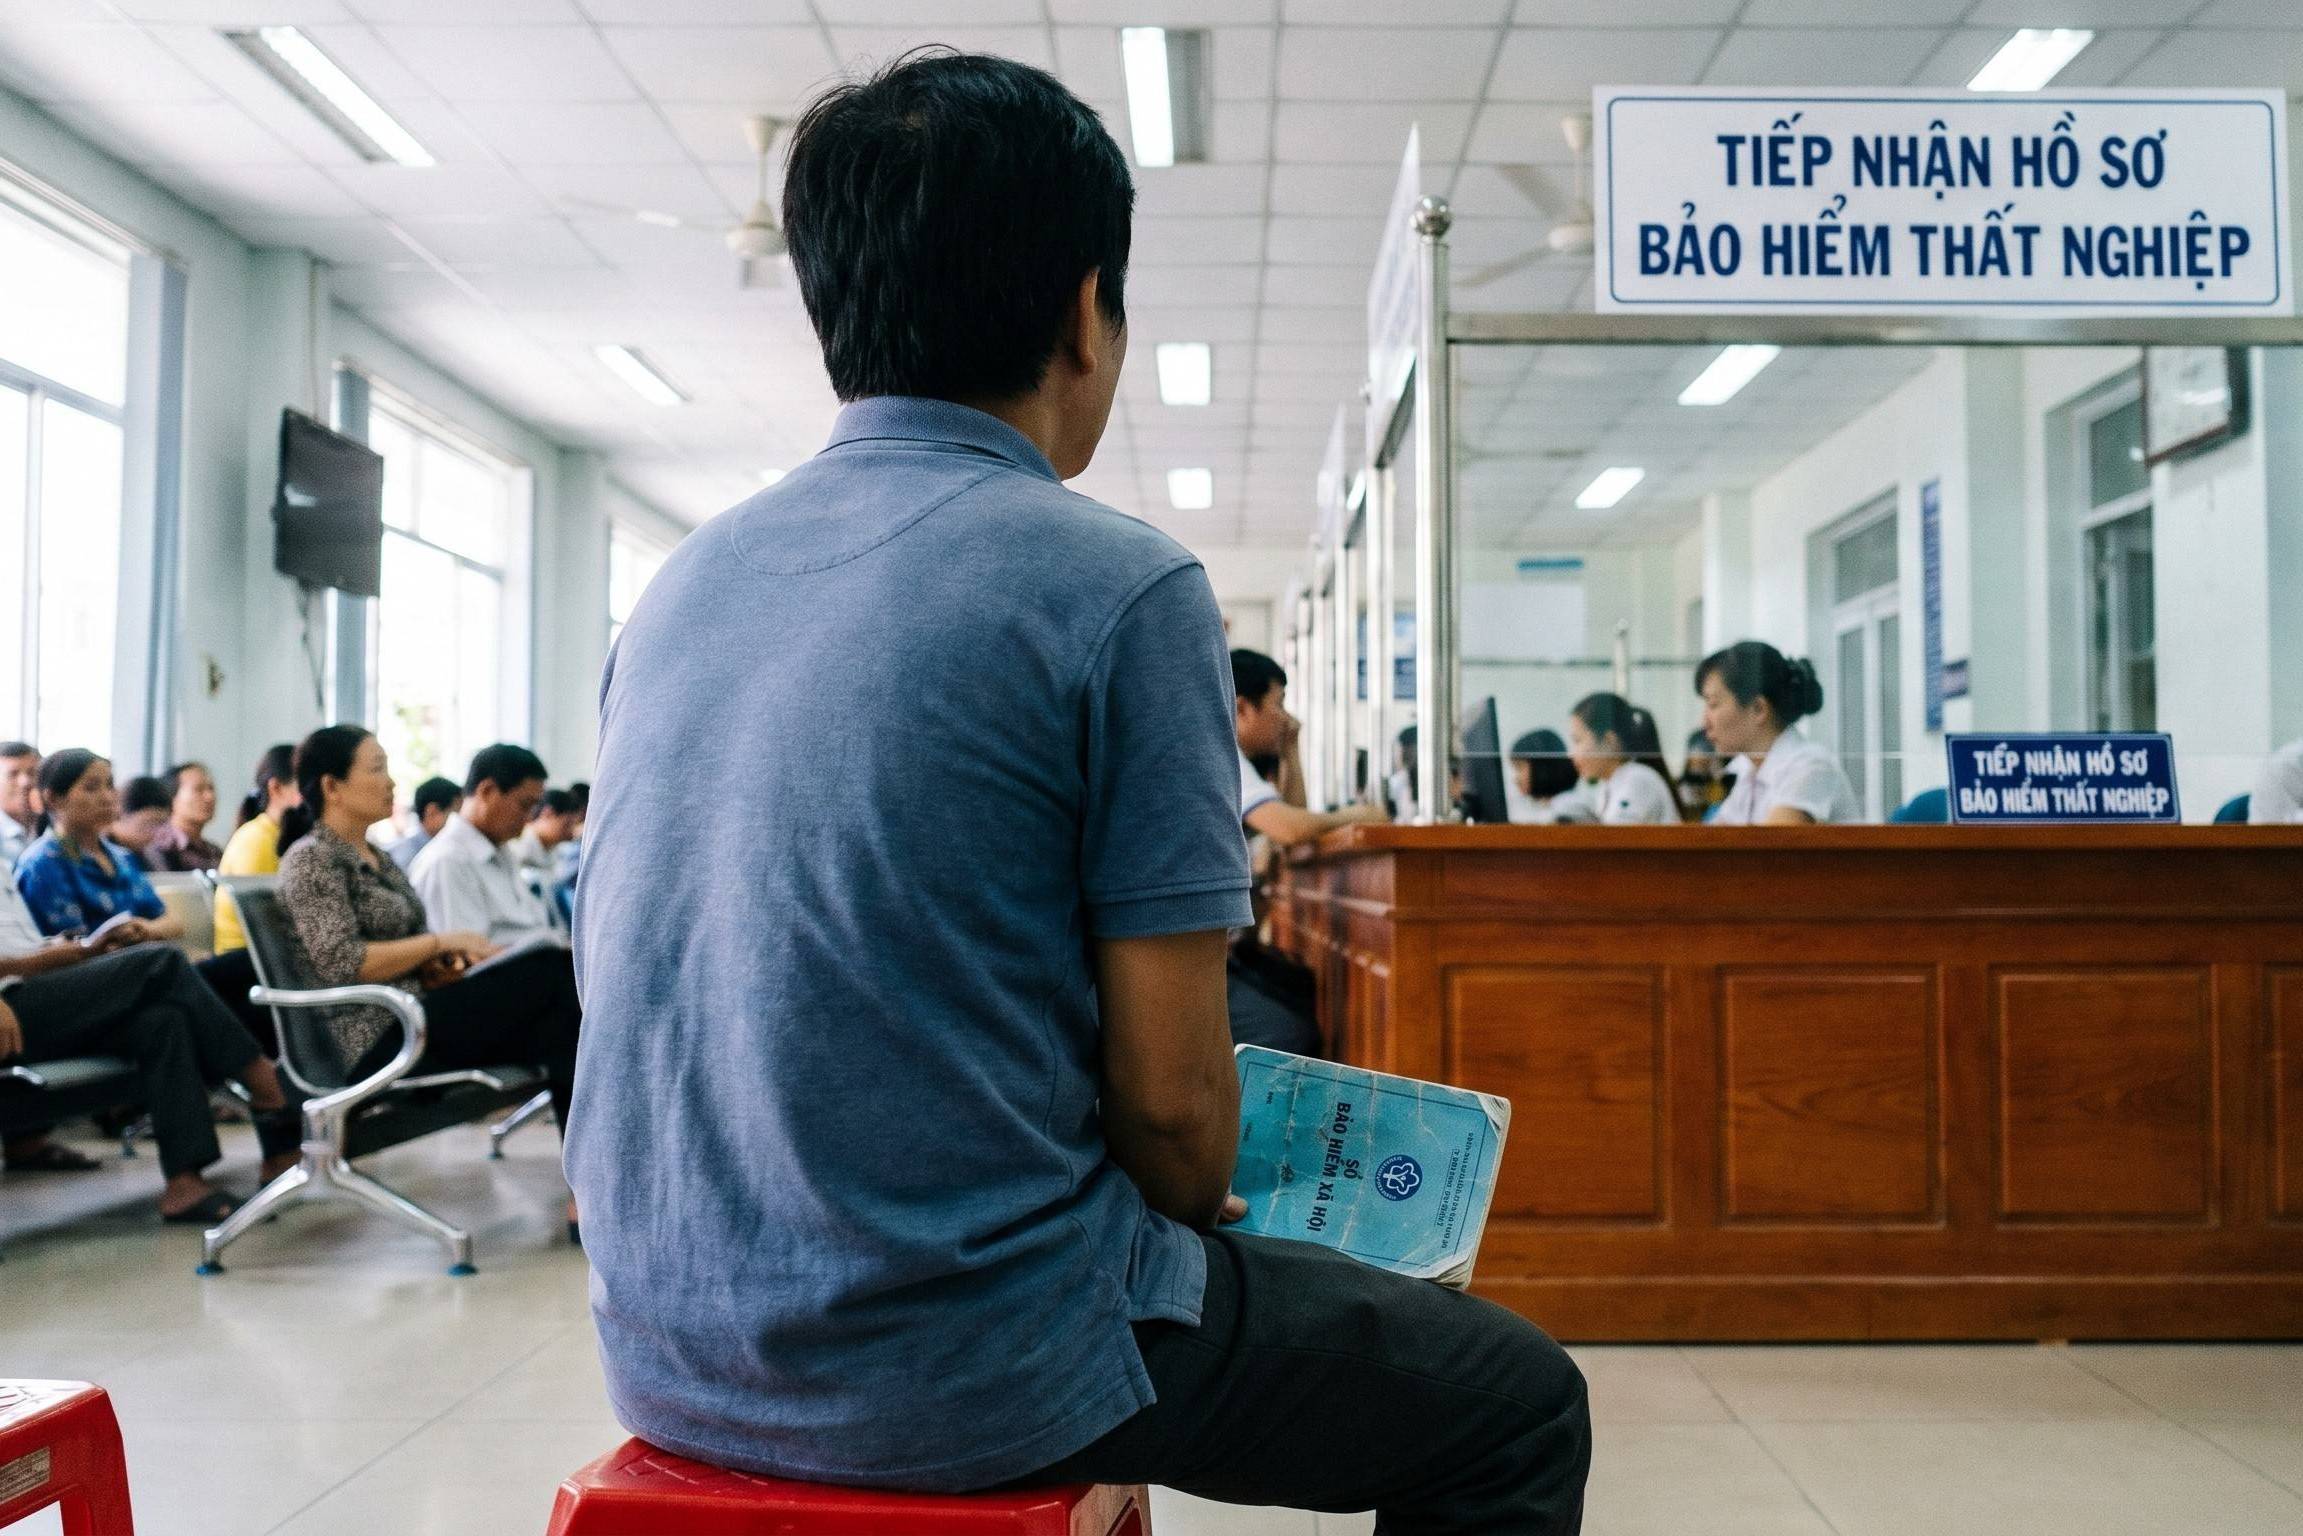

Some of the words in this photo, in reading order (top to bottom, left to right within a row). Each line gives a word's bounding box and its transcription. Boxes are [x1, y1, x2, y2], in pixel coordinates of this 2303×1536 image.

[1717, 112, 1832, 187] TIẾP
[1852, 119, 1991, 200] NHẬN
[2012, 111, 2080, 189] HỒ
[2100, 129, 2168, 189] SƠ
[1639, 202, 1741, 277] BẢO
[1762, 194, 1891, 277] HIỂM
[1909, 203, 2041, 277] THẤT
[2062, 210, 2250, 291] NGHIỆP
[2119, 748, 2148, 776] SƠ
